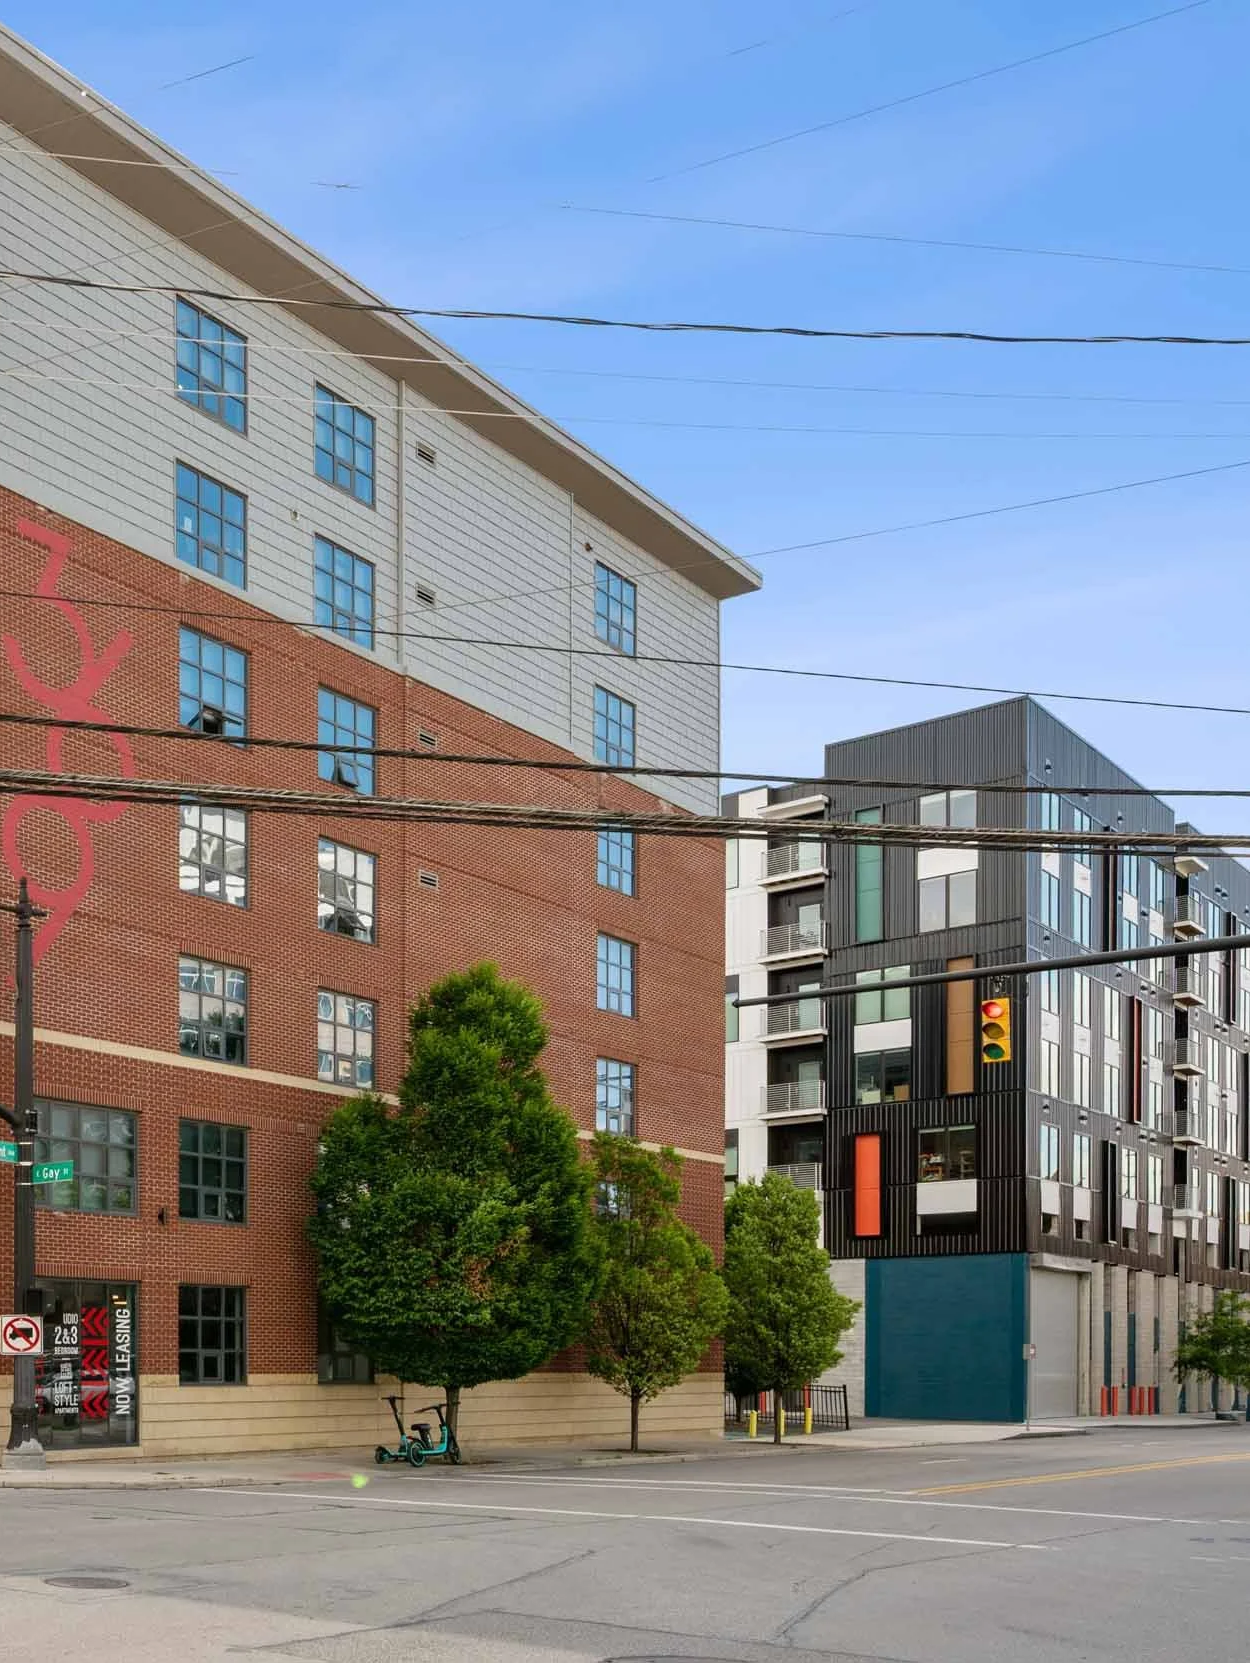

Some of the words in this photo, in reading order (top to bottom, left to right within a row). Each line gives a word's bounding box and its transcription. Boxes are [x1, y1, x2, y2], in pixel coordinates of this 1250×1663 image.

[42, 1167, 60, 1180] Gay
[54, 1327, 78, 1345] 2&3
[115, 1308, 131, 1372] LEASING
[54, 1395, 79, 1406] STYLE
[115, 1376, 131, 1415] NOW
